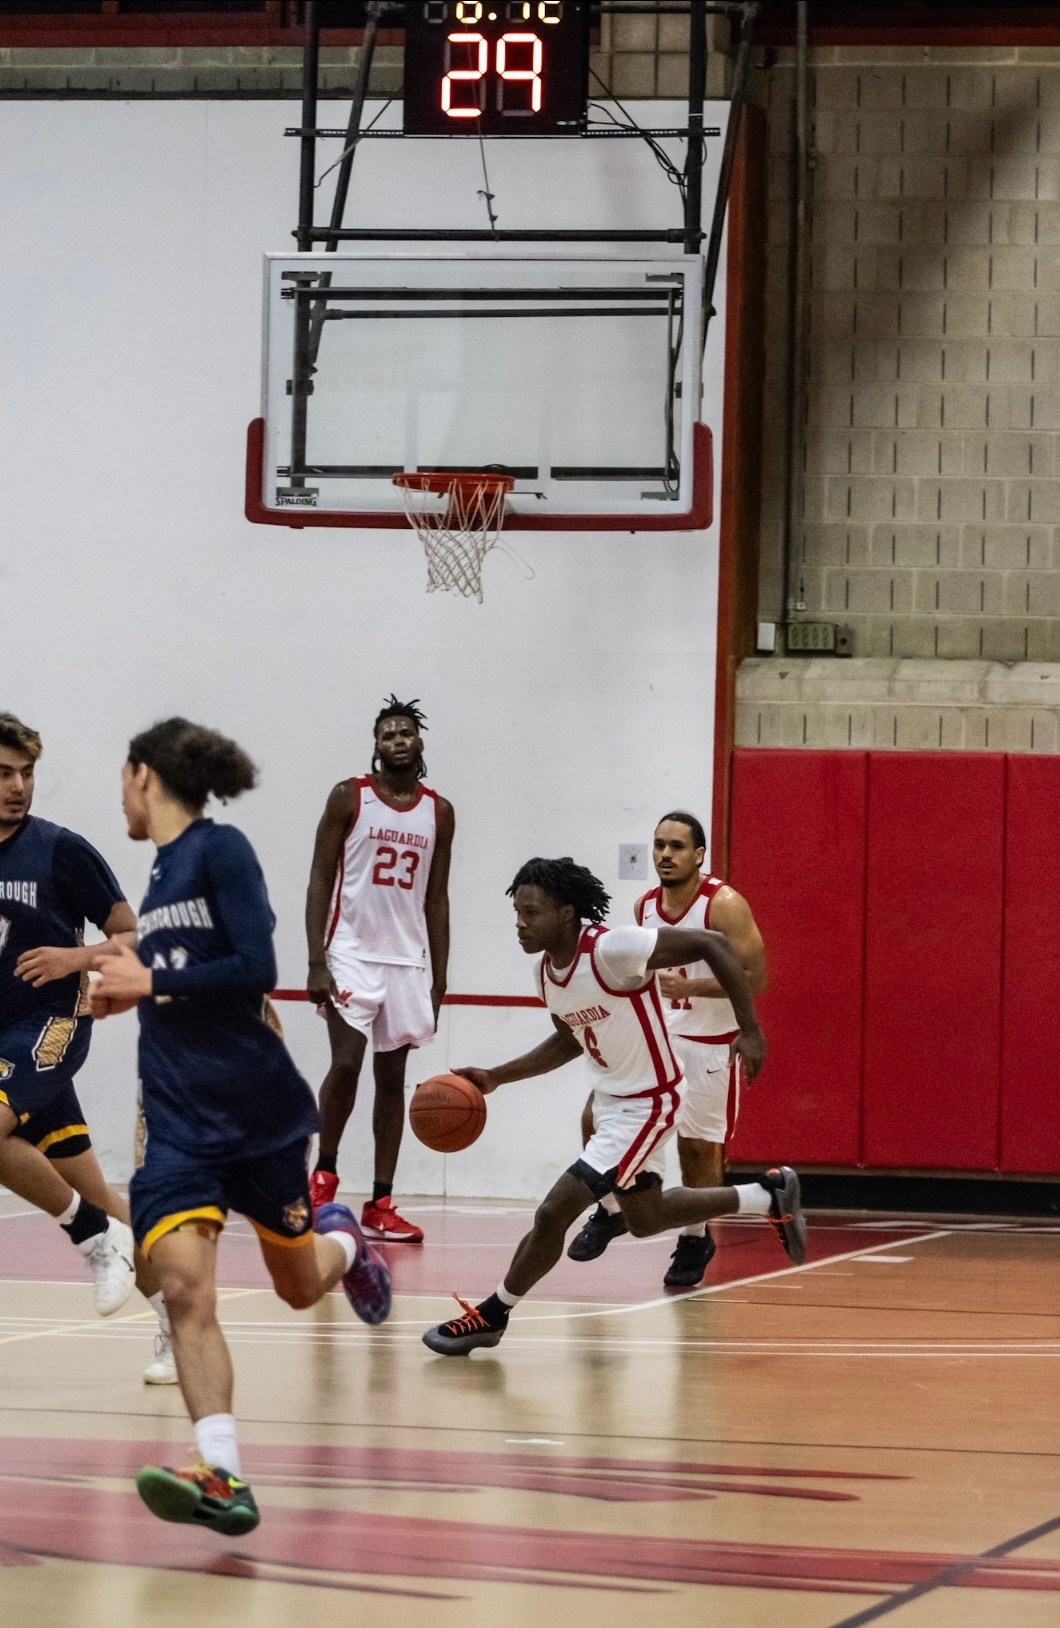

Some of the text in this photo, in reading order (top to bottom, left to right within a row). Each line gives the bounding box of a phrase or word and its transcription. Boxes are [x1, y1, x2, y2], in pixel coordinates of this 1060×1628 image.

[441, 32, 543, 117] 29
[275, 496, 318, 506] SPALDING
[372, 846, 420, 890] 23
